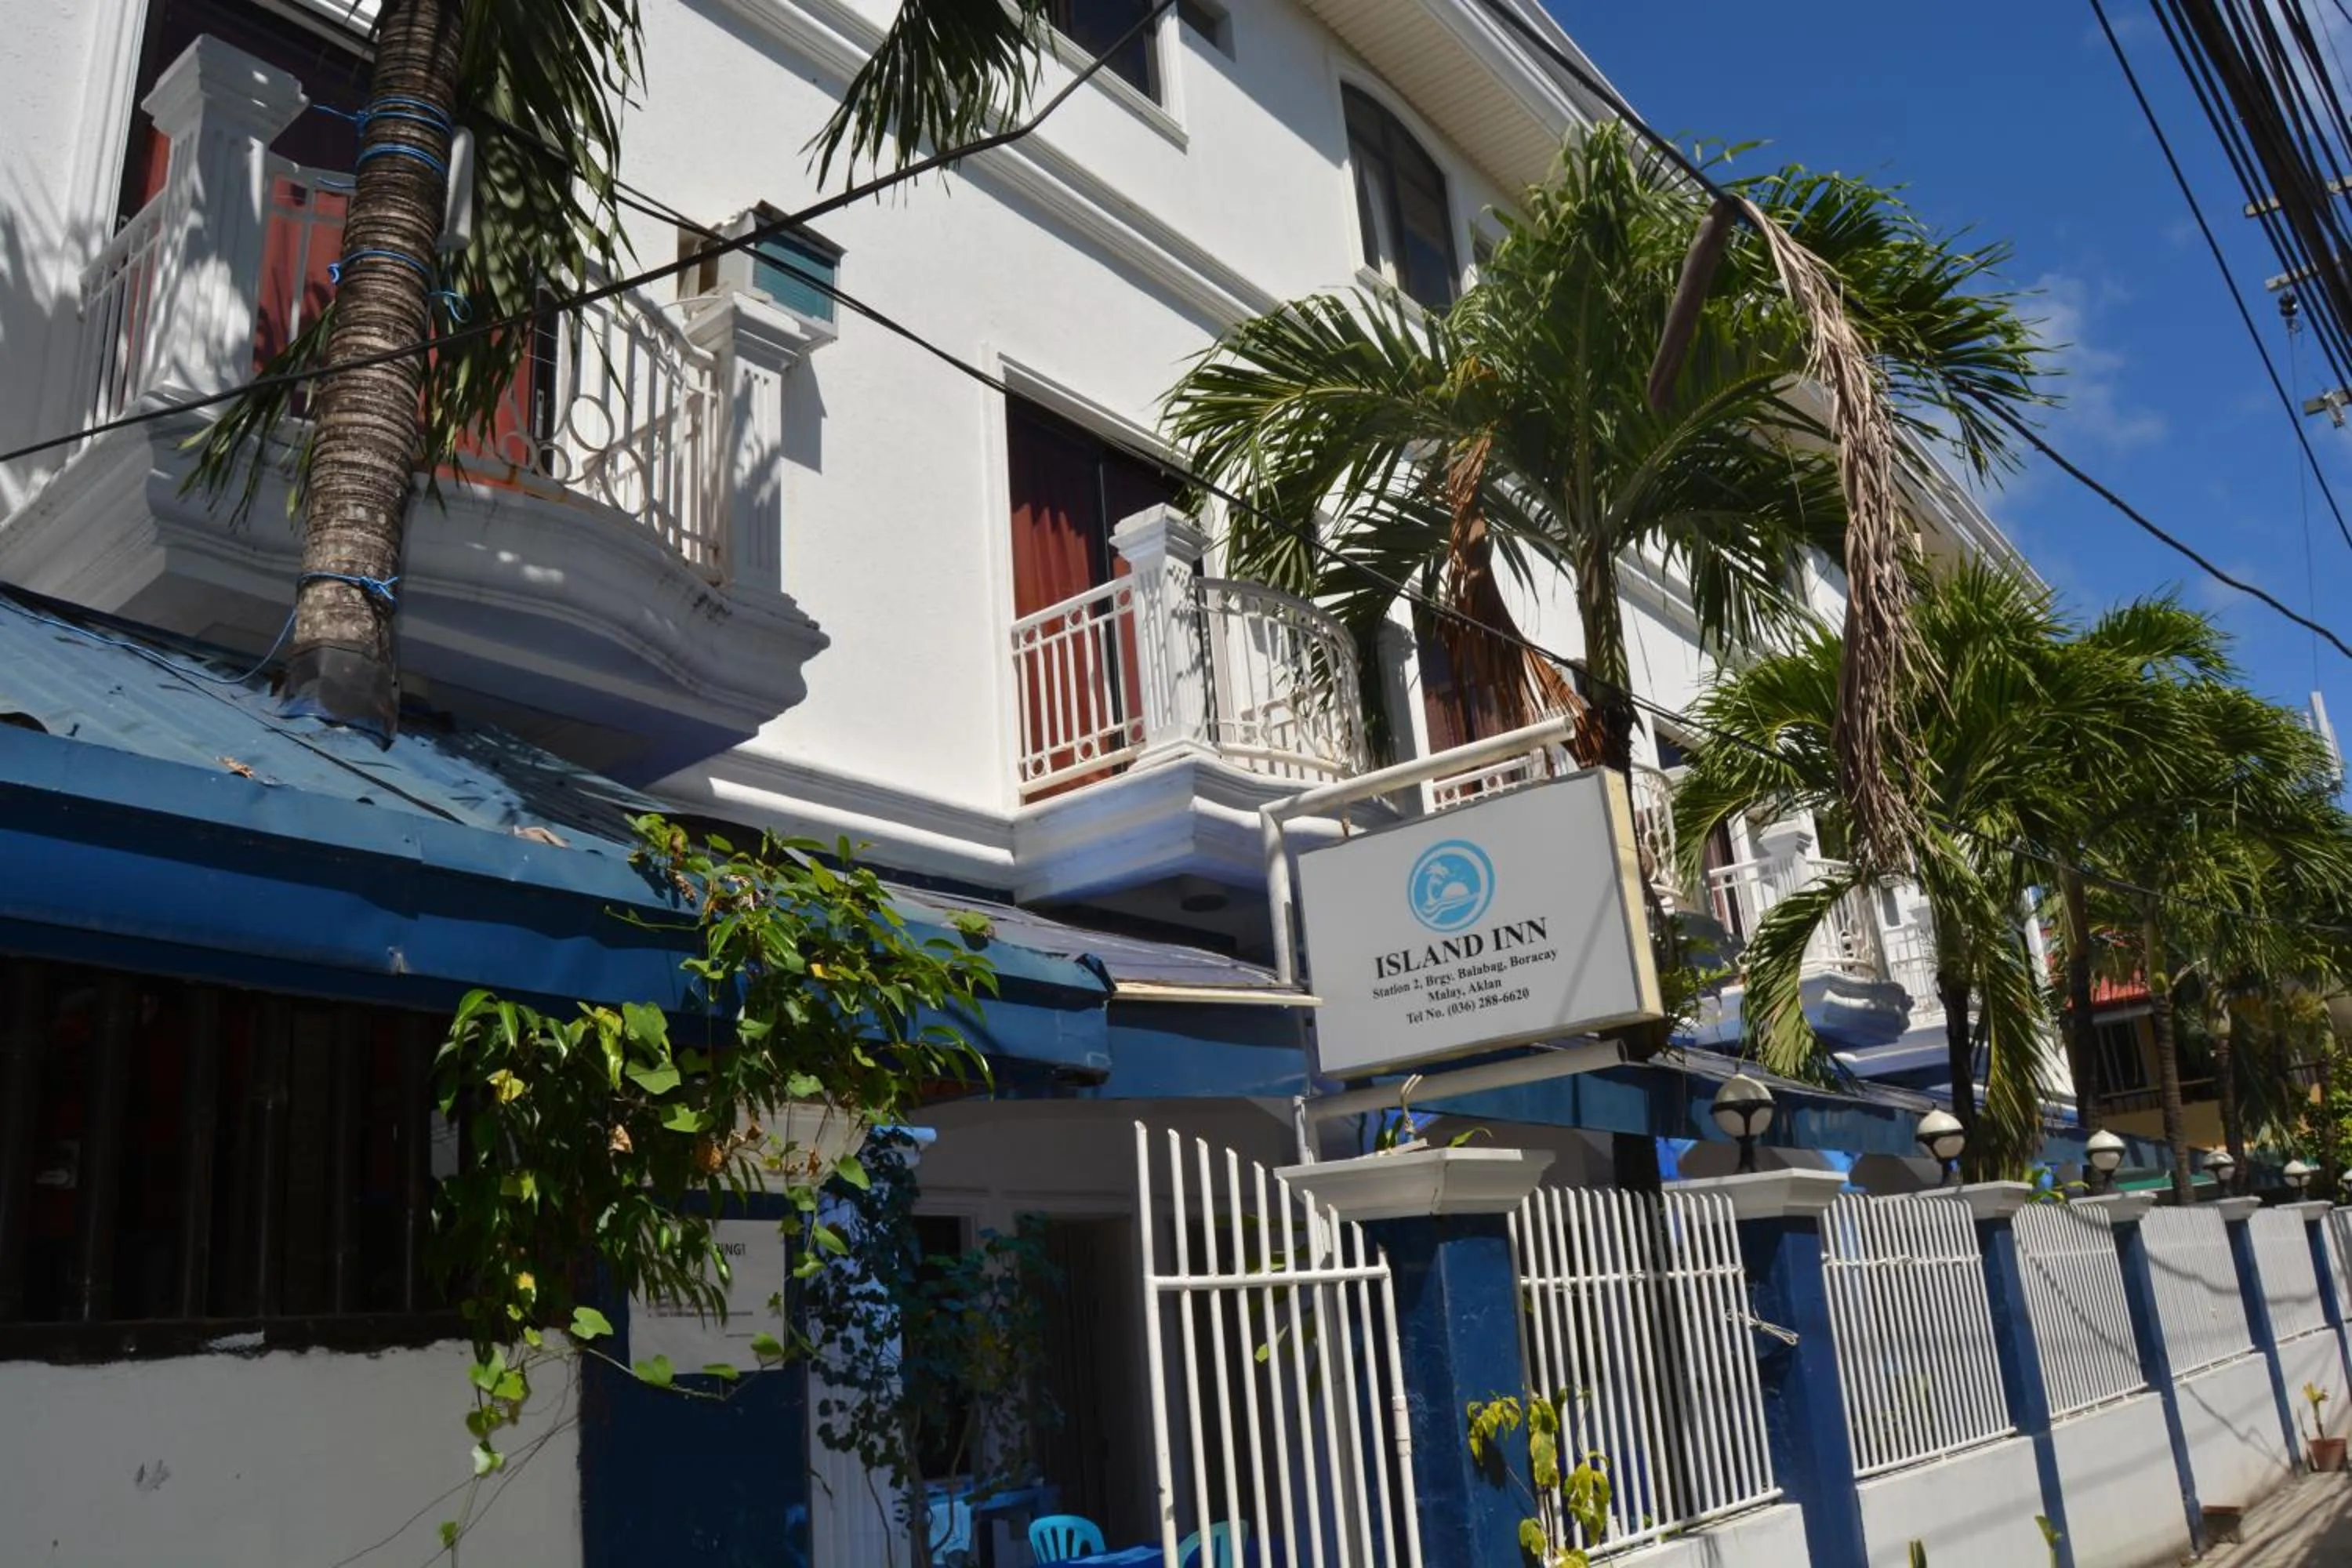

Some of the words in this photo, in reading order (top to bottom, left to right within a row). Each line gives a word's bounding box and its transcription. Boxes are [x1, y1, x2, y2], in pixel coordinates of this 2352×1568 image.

[1375, 934, 1484, 978] ISLAND
[1492, 916, 1547, 952] INN
[1373, 983, 1410, 999] Station
[1414, 978, 1423, 989] 2,
[1425, 973, 1455, 986] Brgy.
[1457, 962, 1508, 979] Balabag,
[1510, 948, 1558, 968] Boracay
[1428, 988, 1466, 1002] Malay,
[1468, 979, 1502, 994] Aklan
[1406, 1010, 1423, 1024] Tel
[1425, 1007, 1445, 1019] No.
[1447, 1000, 1475, 1017] (036)
[1479, 987, 1530, 1009] 288-6620
